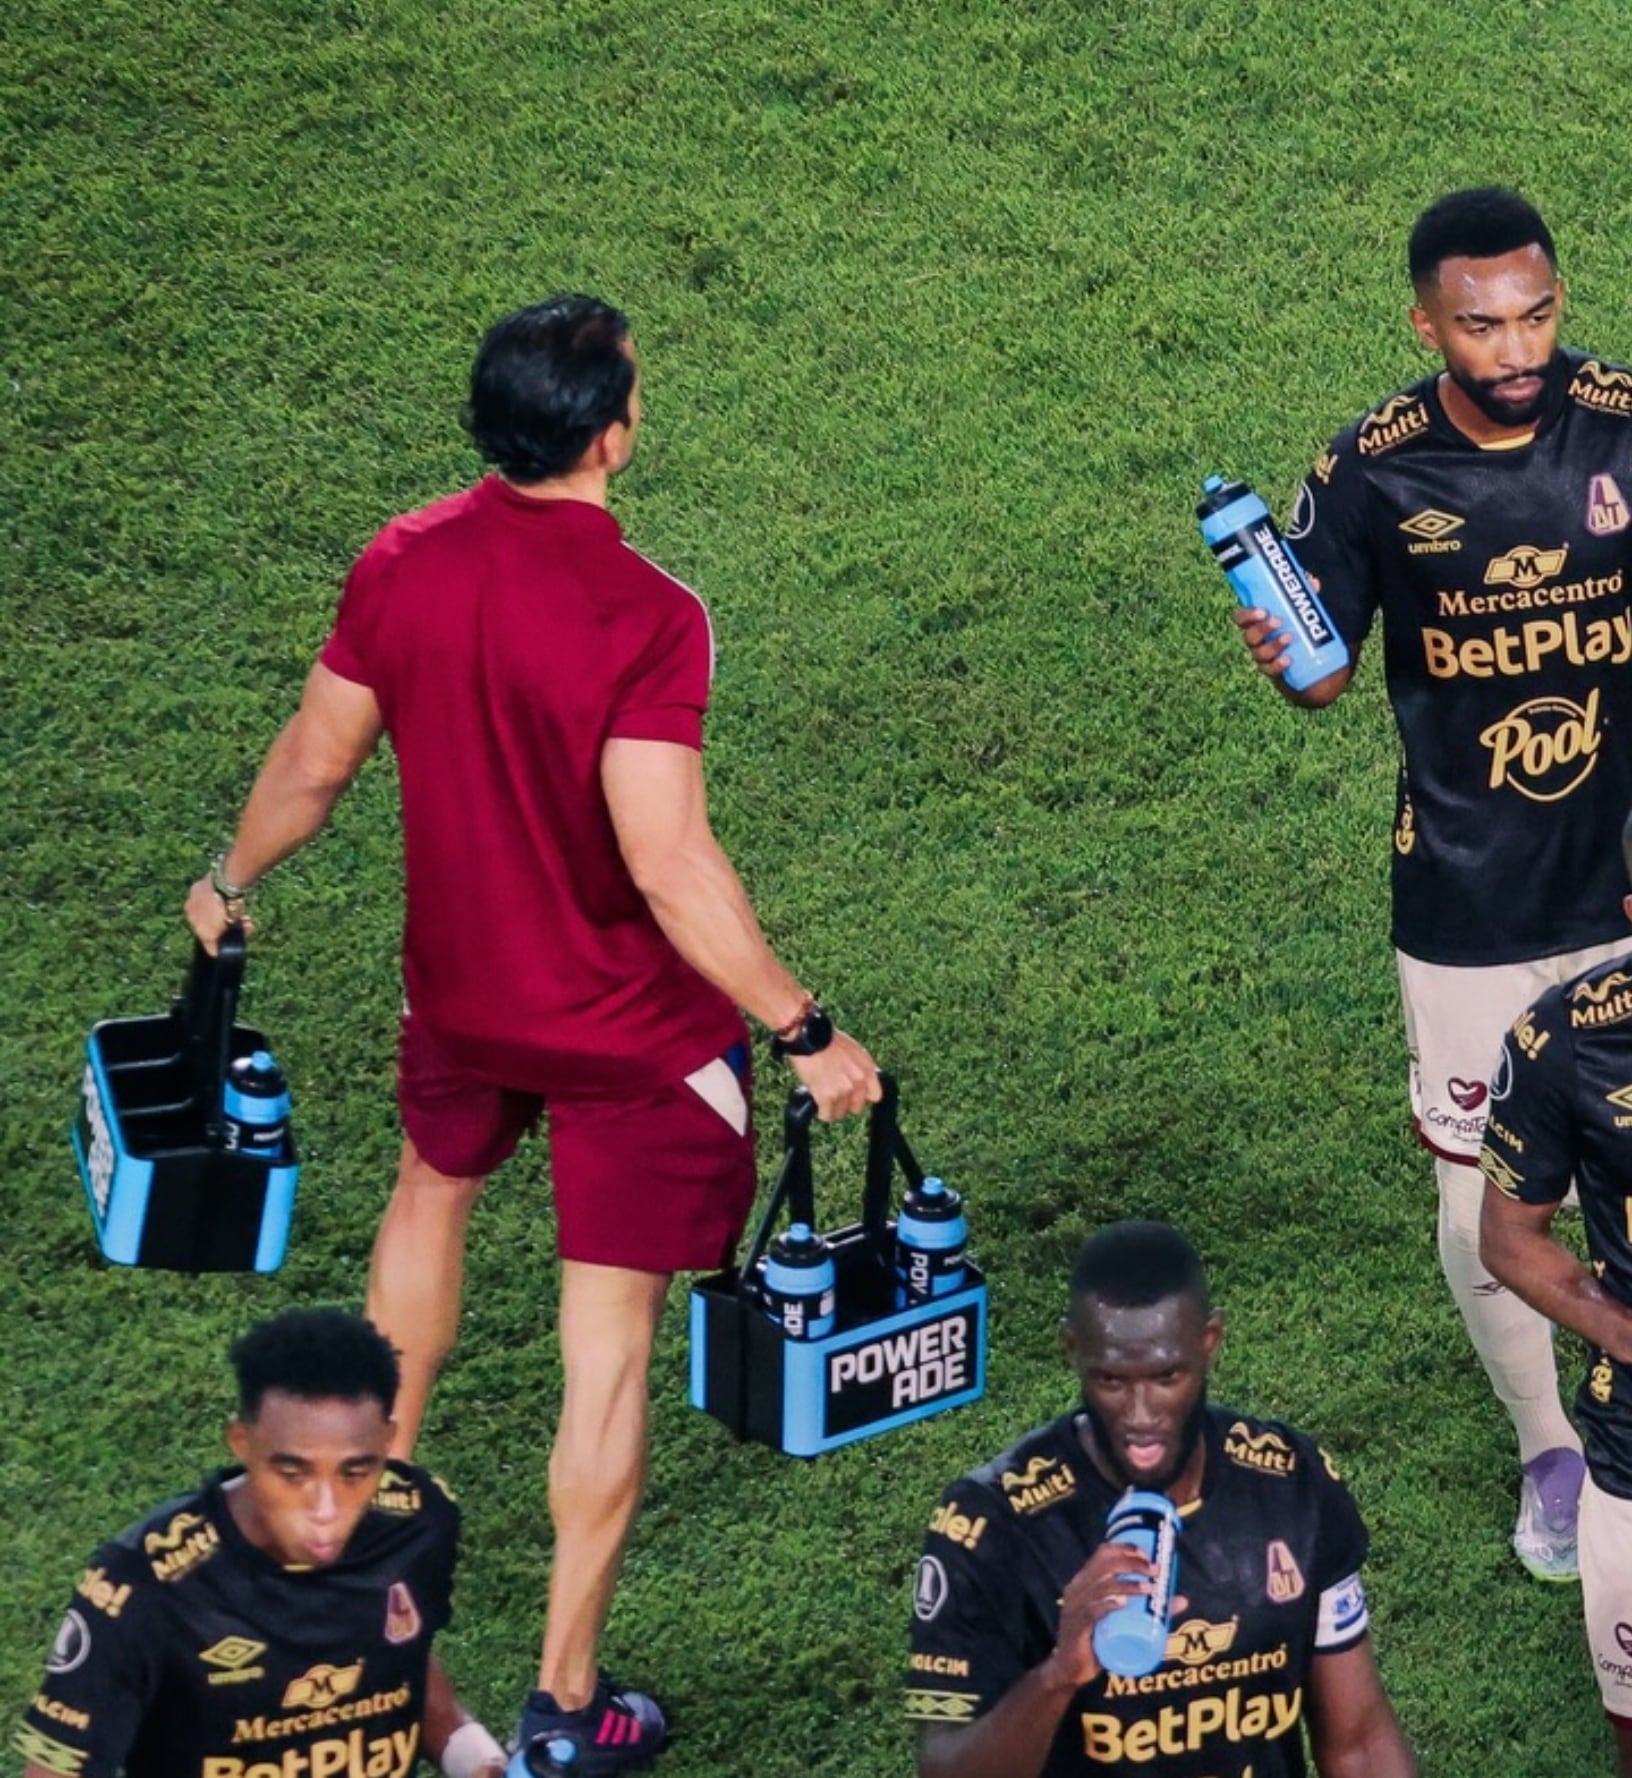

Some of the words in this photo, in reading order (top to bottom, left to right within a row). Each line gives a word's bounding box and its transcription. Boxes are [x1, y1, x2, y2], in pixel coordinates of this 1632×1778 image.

[1357, 402, 1430, 455] Multi
[1407, 539, 1462, 555] umbro
[1253, 522, 1328, 641] POWERADE
[1437, 575, 1623, 618] Mercacentro
[1478, 687, 1602, 789] Pool
[831, 1315, 968, 1394] POWER
[892, 1351, 967, 1409] ADE
[1224, 1437, 1297, 1472] Multi
[1008, 1463, 1077, 1515] Multi
[909, 1652, 971, 1678] OLCIM
[1103, 1646, 1289, 1699] Mercacentro
[230, 1686, 411, 1744] Mercacentro
[1081, 1687, 1303, 1764] BetPlay
